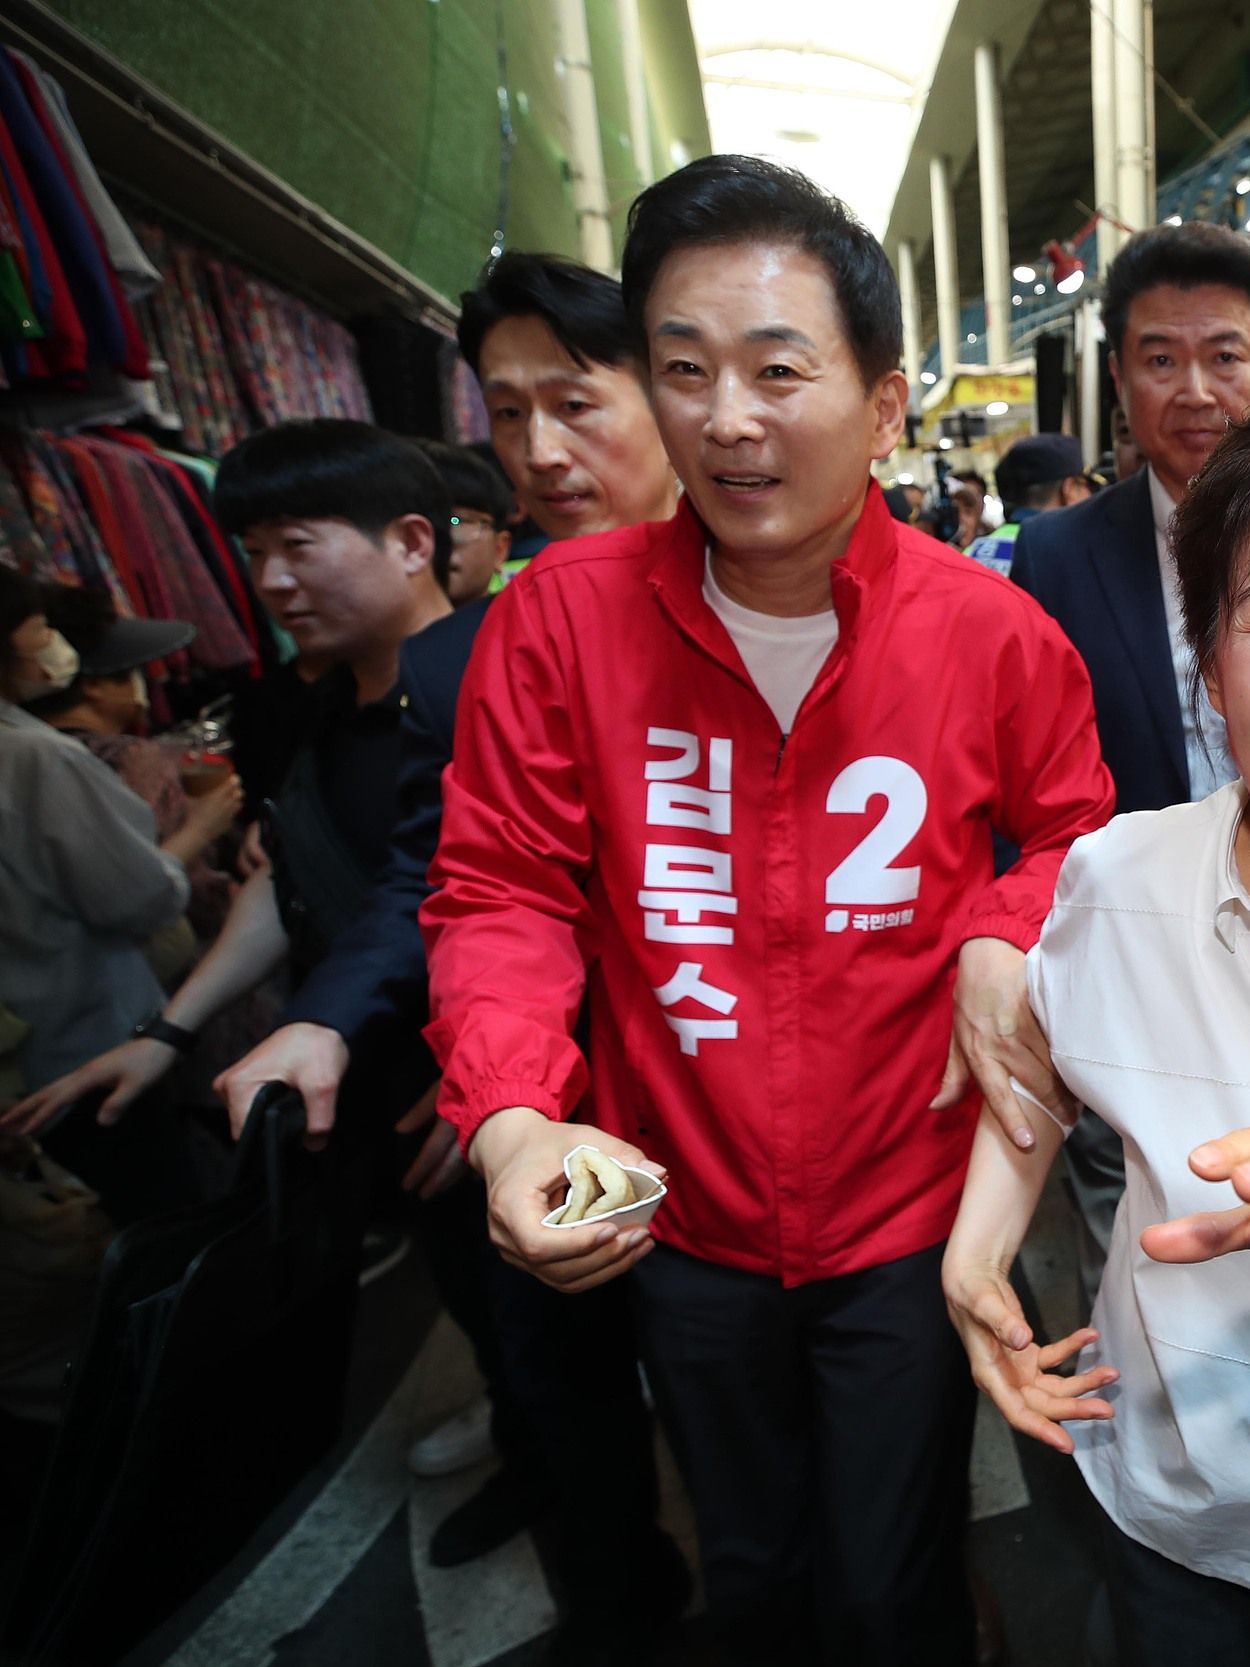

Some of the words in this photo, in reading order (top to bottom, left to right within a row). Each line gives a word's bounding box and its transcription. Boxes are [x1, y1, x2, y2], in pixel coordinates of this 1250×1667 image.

[637, 726, 739, 1057] 김문수
[825, 755, 928, 905] 2
[852, 908, 915, 932] 국민의힘
